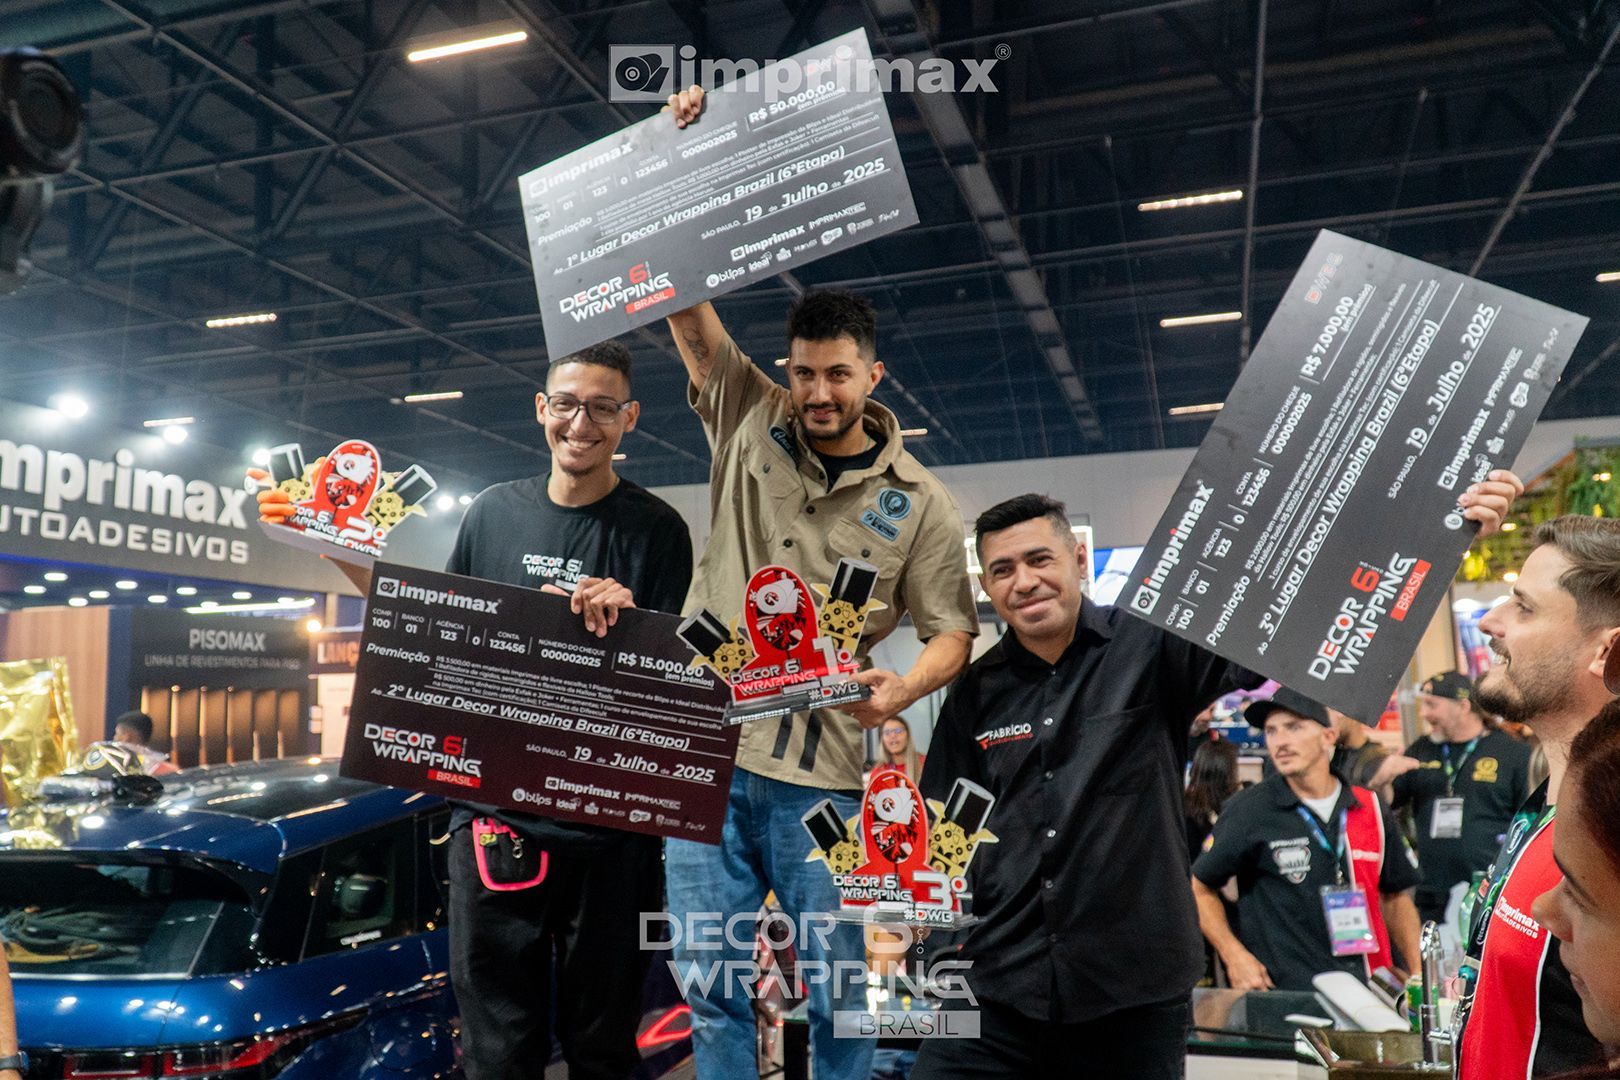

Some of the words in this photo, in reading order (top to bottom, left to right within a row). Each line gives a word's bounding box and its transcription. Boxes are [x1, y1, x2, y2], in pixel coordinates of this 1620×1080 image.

[748, 106, 768, 124] R$
[768, 78, 836, 116] 50.000,00
[681, 128, 737, 159] 000002025
[547, 139, 633, 189] imprimax
[635, 158, 668, 179] 123456
[592, 184, 607, 197] 123
[620, 176, 628, 186] 0
[562, 199, 573, 210] 01
[700, 228, 716, 240] SÃO
[744, 204, 763, 222] 19
[768, 204, 778, 213] de
[779, 177, 829, 208] Julho
[841, 156, 886, 184] 2025
[533, 209, 550, 224] 100
[566, 253, 578, 266] 1º
[579, 237, 619, 264] Lugar
[620, 219, 661, 244] Decor
[662, 189, 732, 229] Wrapping
[733, 171, 775, 198] Brazil
[536, 214, 593, 247] Premiação
[744, 222, 805, 255] imprimax
[718, 263, 745, 284] blips
[558, 275, 623, 313] DECOR
[628, 262, 647, 285] 6
[570, 271, 672, 324] WRAPPING
[633, 290, 668, 311] BRASIL
[1299, 353, 1323, 377] R$
[1311, 294, 1356, 357] 7.000,00
[1459, 302, 1497, 349] 2025
[1460, 348, 1473, 360] de
[1424, 357, 1467, 412] Julho
[1274, 412, 1285, 424] DO
[1280, 384, 1301, 413] CHEQUE
[1362, 387, 1400, 436] Brazil
[1270, 390, 1312, 456] 000002025
[1425, 413, 1438, 425] de
[1404, 425, 1430, 450] 19
[1445, 406, 1493, 474] imprimax
[1320, 434, 1378, 517] Wrapping
[1396, 452, 1418, 482] PAULO,
[0, 439, 249, 529] mprimax
[1235, 469, 1253, 495] CONTA
[1241, 466, 1271, 508] 123456
[1386, 480, 1403, 499] SÃO
[1232, 513, 1246, 525] 0
[1142, 480, 1216, 592] imprimax
[1200, 526, 1222, 558] AGÊNCIA
[1214, 537, 1233, 559] 123
[1294, 513, 1333, 565] Decor
[522, 554, 564, 568] DECOR
[566, 558, 581, 573] 6
[1181, 568, 1200, 595] BANCO
[1194, 578, 1210, 595] 01
[1268, 562, 1309, 616] Lugar
[1395, 568, 1427, 611] BRASIL
[398, 580, 499, 617] imprimax
[1204, 572, 1254, 648] Premiação
[371, 617, 390, 628] 100
[401, 613, 424, 623] BANCO
[405, 623, 417, 633] 01
[435, 618, 464, 630] AGÊNCIA
[1175, 607, 1196, 632] 100
[1257, 611, 1280, 635] 3º
[1306, 594, 1366, 681] DECOR
[1348, 564, 1382, 595] 6
[1333, 550, 1417, 681] WRAPPING
[189, 628, 266, 651] PISOMAX
[439, 629, 457, 641] 123
[471, 636, 480, 645] 0
[488, 638, 525, 654] 123456
[497, 631, 520, 640] CONTA
[538, 638, 567, 649] NÚMERO
[578, 646, 605, 656] CHEQUE
[1256, 640, 1269, 655] Ao
[145, 654, 174, 667] LINHA
[176, 655, 189, 667] DE
[365, 642, 430, 665] Premiação
[540, 648, 601, 668] 000002025
[617, 650, 638, 666] R$
[638, 655, 704, 679] 15.000,00
[664, 672, 680, 681] (em
[680, 674, 715, 688] prêmios)
[730, 664, 780, 686] DECOR
[784, 659, 801, 676] 6
[738, 669, 819, 696] WRAPPING
[808, 681, 860, 701] #DWB
[370, 687, 382, 695] Ao
[386, 682, 405, 697] 2º
[405, 687, 450, 708] Lugar
[451, 695, 497, 714] Decor
[499, 704, 573, 731] Wrapping
[575, 717, 619, 737] Brazil
[363, 723, 436, 750] DECOR
[442, 734, 463, 756] 6
[989, 722, 1032, 740] FABRÍCIO
[370, 741, 483, 777] WRAPPING
[525, 742, 541, 753] SÃO
[541, 747, 567, 757] PAULO,
[573, 745, 592, 761] 19
[596, 756, 606, 764] de
[609, 751, 659, 773] Julho
[672, 762, 715, 783] 2025
[436, 771, 473, 786] BRASIL
[559, 779, 620, 800] imprimax
[525, 791, 552, 807] blips
[832, 874, 879, 888] DECOR
[883, 874, 897, 889] 6
[840, 887, 914, 903] WRAPPING
[903, 908, 953, 923] #DWB
